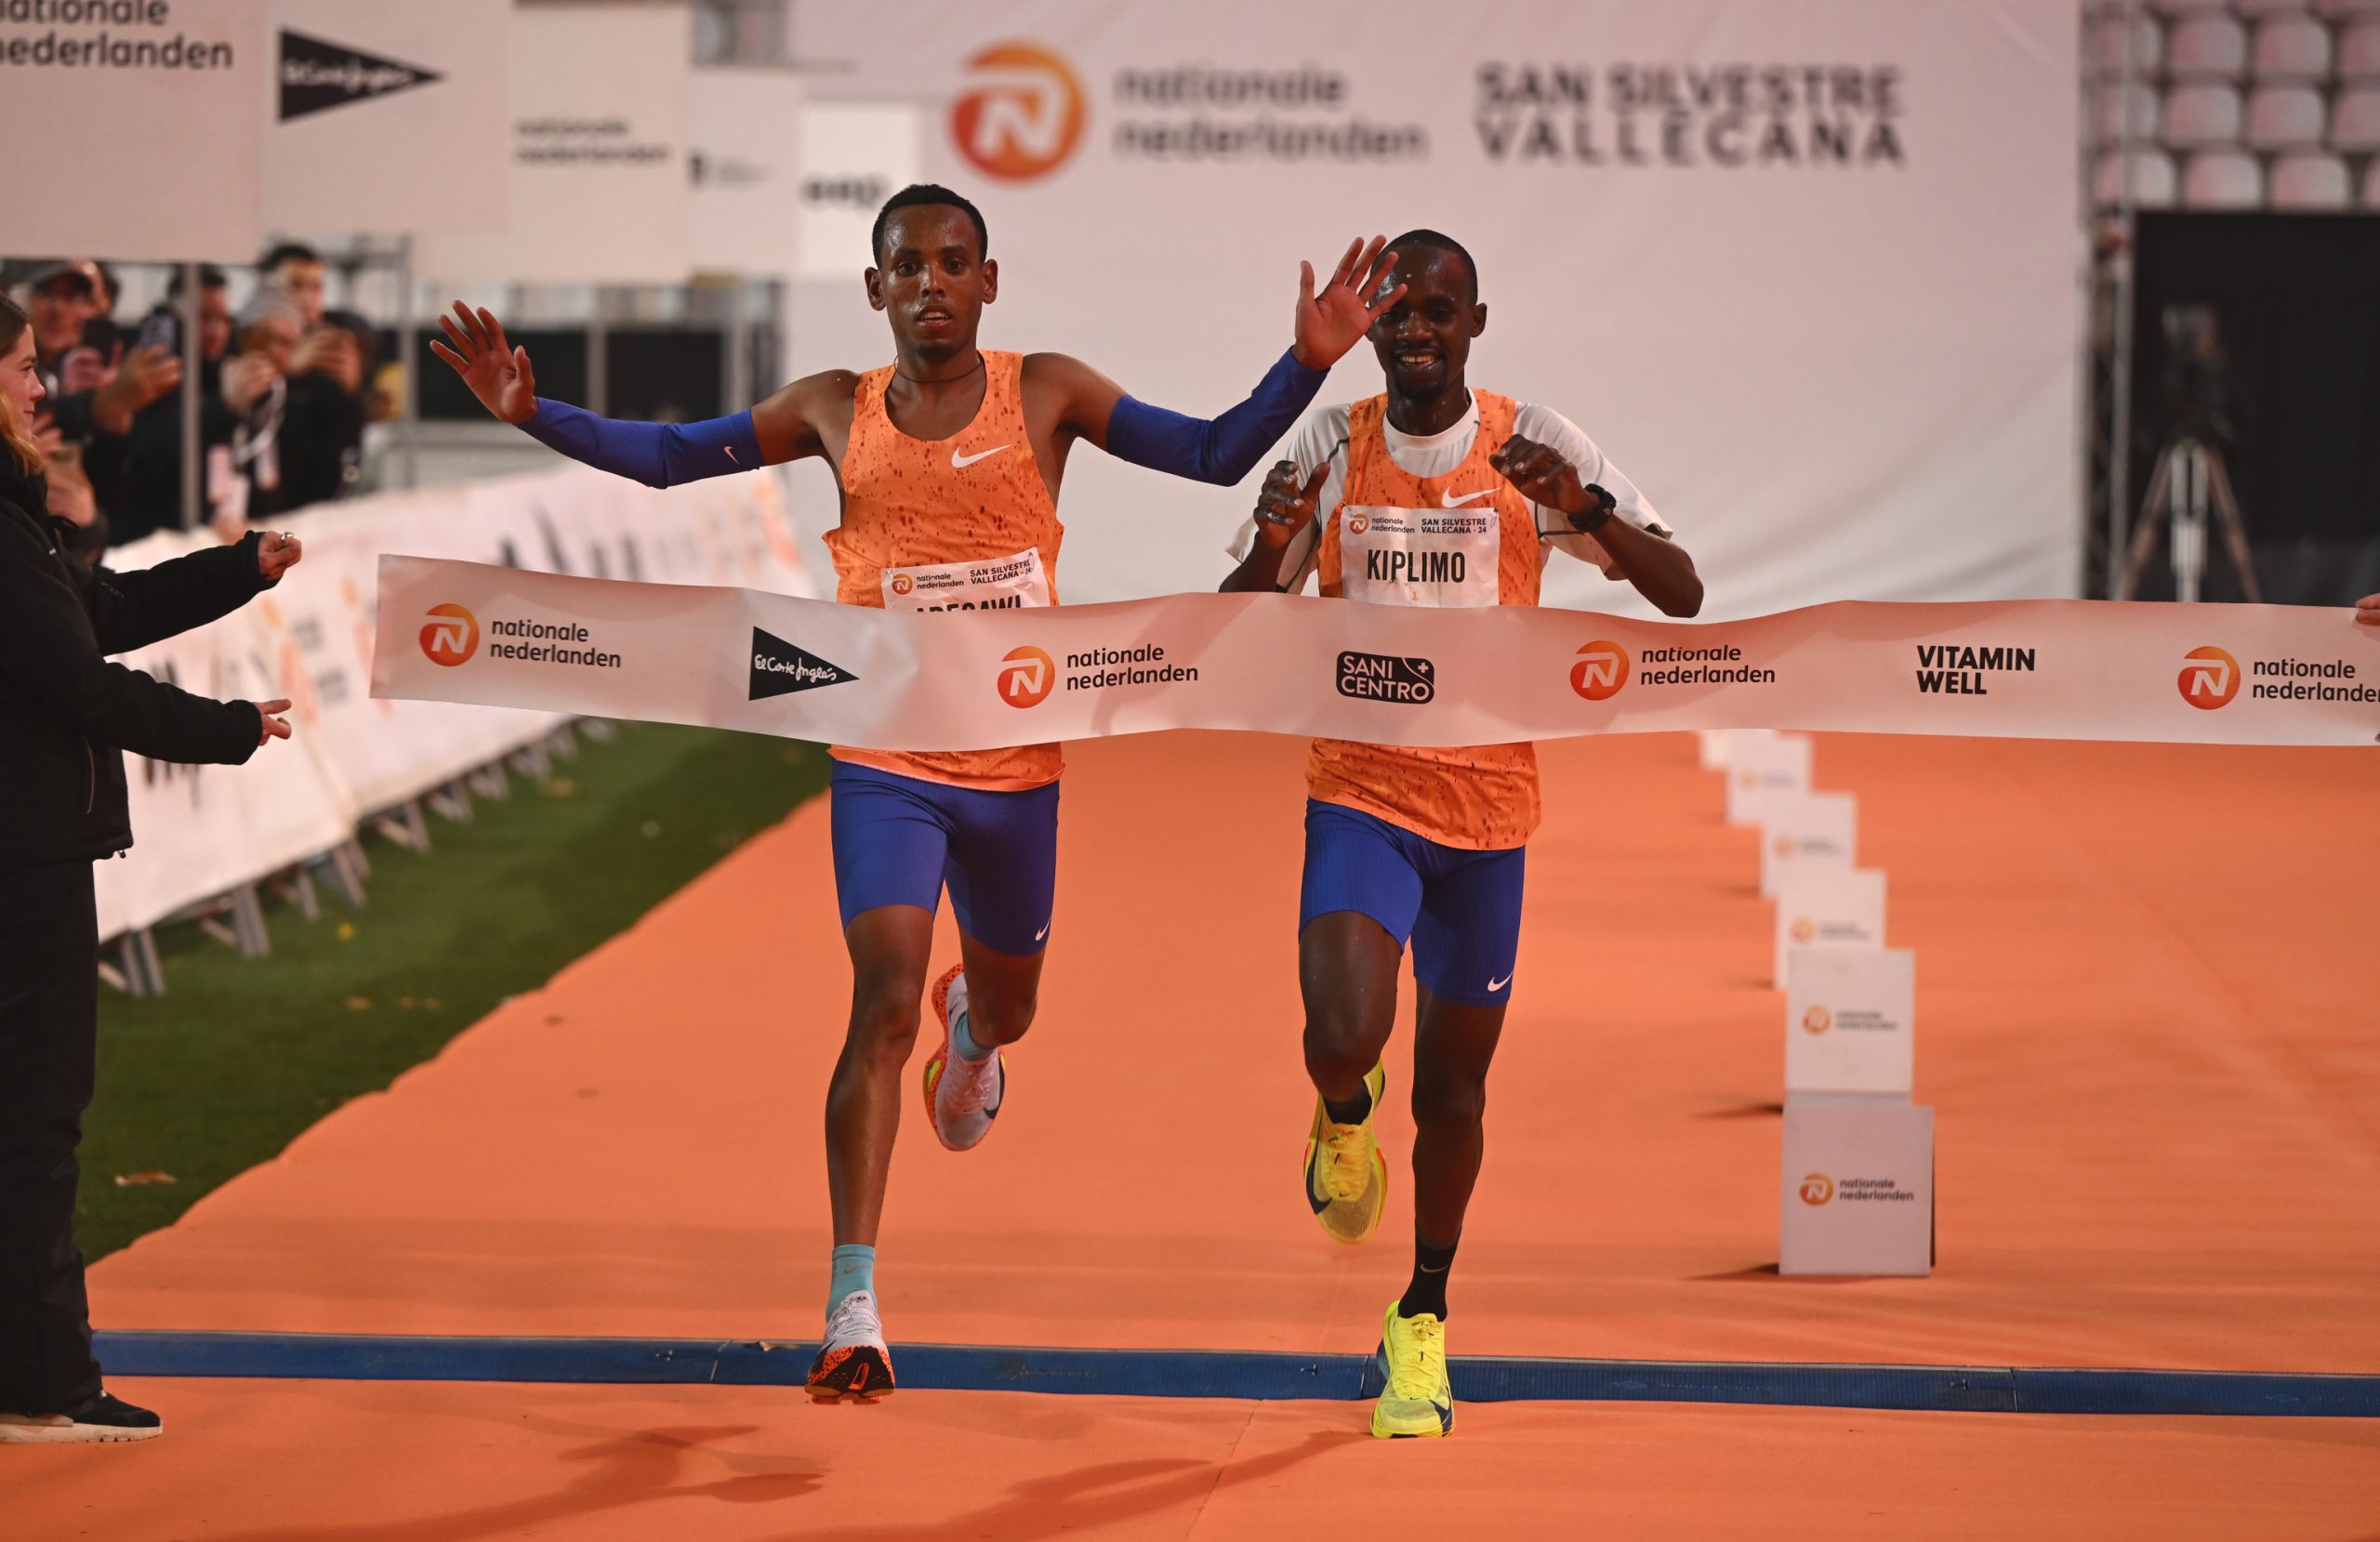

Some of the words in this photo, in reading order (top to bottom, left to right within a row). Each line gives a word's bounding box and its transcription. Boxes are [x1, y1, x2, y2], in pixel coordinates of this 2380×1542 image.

[0, 0, 169, 25] ationale
[0, 32, 234, 69] ederlanden
[1476, 62, 1593, 107] SAN
[1606, 62, 1904, 113] SILVESTRE
[1476, 119, 1906, 167] VALLECANA
[1371, 525, 1415, 534] nederlanden
[1372, 517, 1404, 525] nationale
[1442, 518, 1487, 526] SILVESTRE
[917, 573, 952, 582] nationale
[970, 568, 988, 577] SAN
[991, 560, 1031, 574] SILVESTRE
[971, 570, 1019, 585] VALLECANA
[1368, 549, 1466, 583] KIPLIMO
[917, 580, 964, 589] nederlanden
[492, 619, 588, 642] nationale
[491, 641, 621, 668] nederlanden
[1067, 644, 1164, 667] nationale
[1642, 645, 1741, 663] nationale
[1916, 645, 2035, 671] VITAMIN
[755, 654, 767, 669] El
[767, 657, 795, 674] Corte
[796, 657, 837, 683] Inglés
[1067, 664, 1198, 691] nederlanden
[1343, 655, 1393, 679] SANI
[1641, 665, 1776, 685] nederlanden
[2254, 658, 2356, 679] nationale
[1342, 675, 1430, 701] CENTRO
[1916, 670, 1988, 694] WELL
[2253, 680, 2380, 703] nederlande
[1840, 1178, 1895, 1189] nationale
[1840, 1190, 1914, 1201] nederlanden
